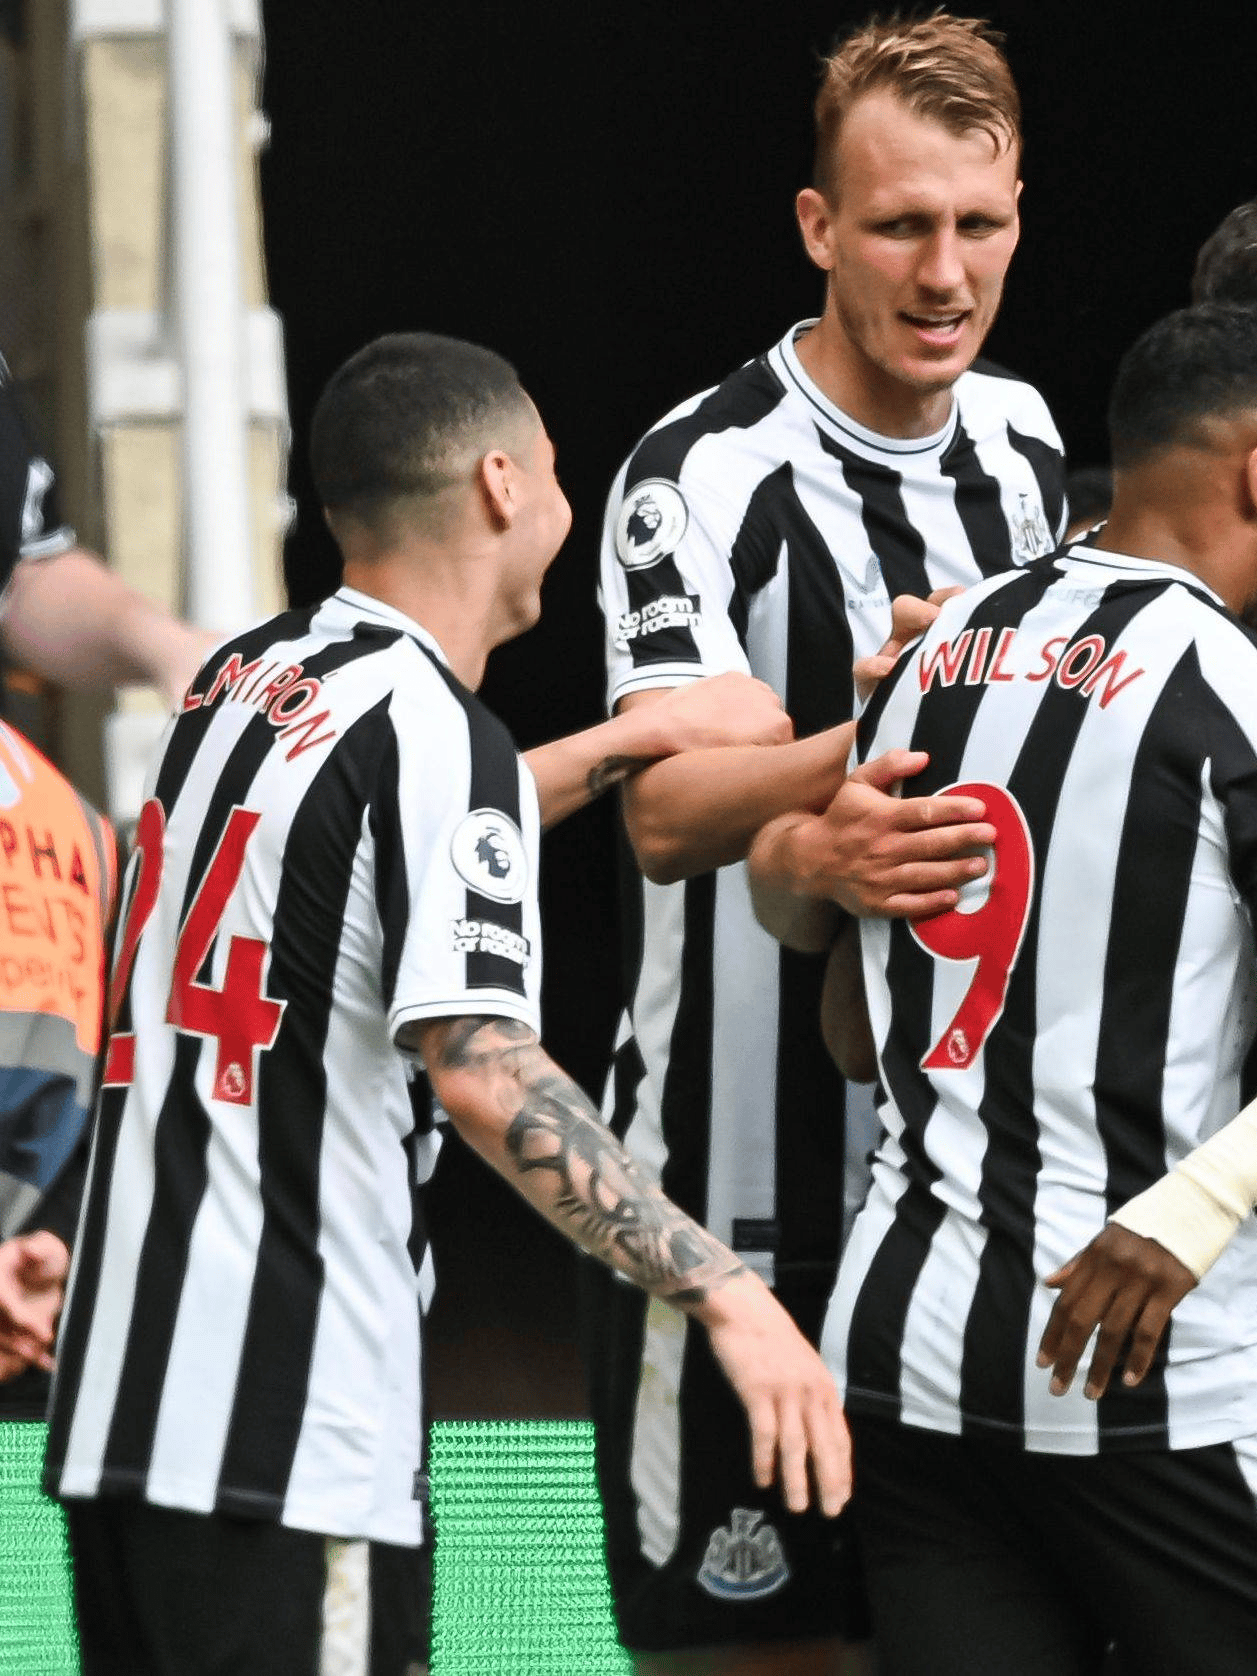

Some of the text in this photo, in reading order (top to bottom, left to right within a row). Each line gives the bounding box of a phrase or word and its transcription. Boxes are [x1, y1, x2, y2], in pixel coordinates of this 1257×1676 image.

[617, 594, 694, 629] No room
[919, 626, 1147, 711] WILSON
[907, 781, 1035, 1072] 9
